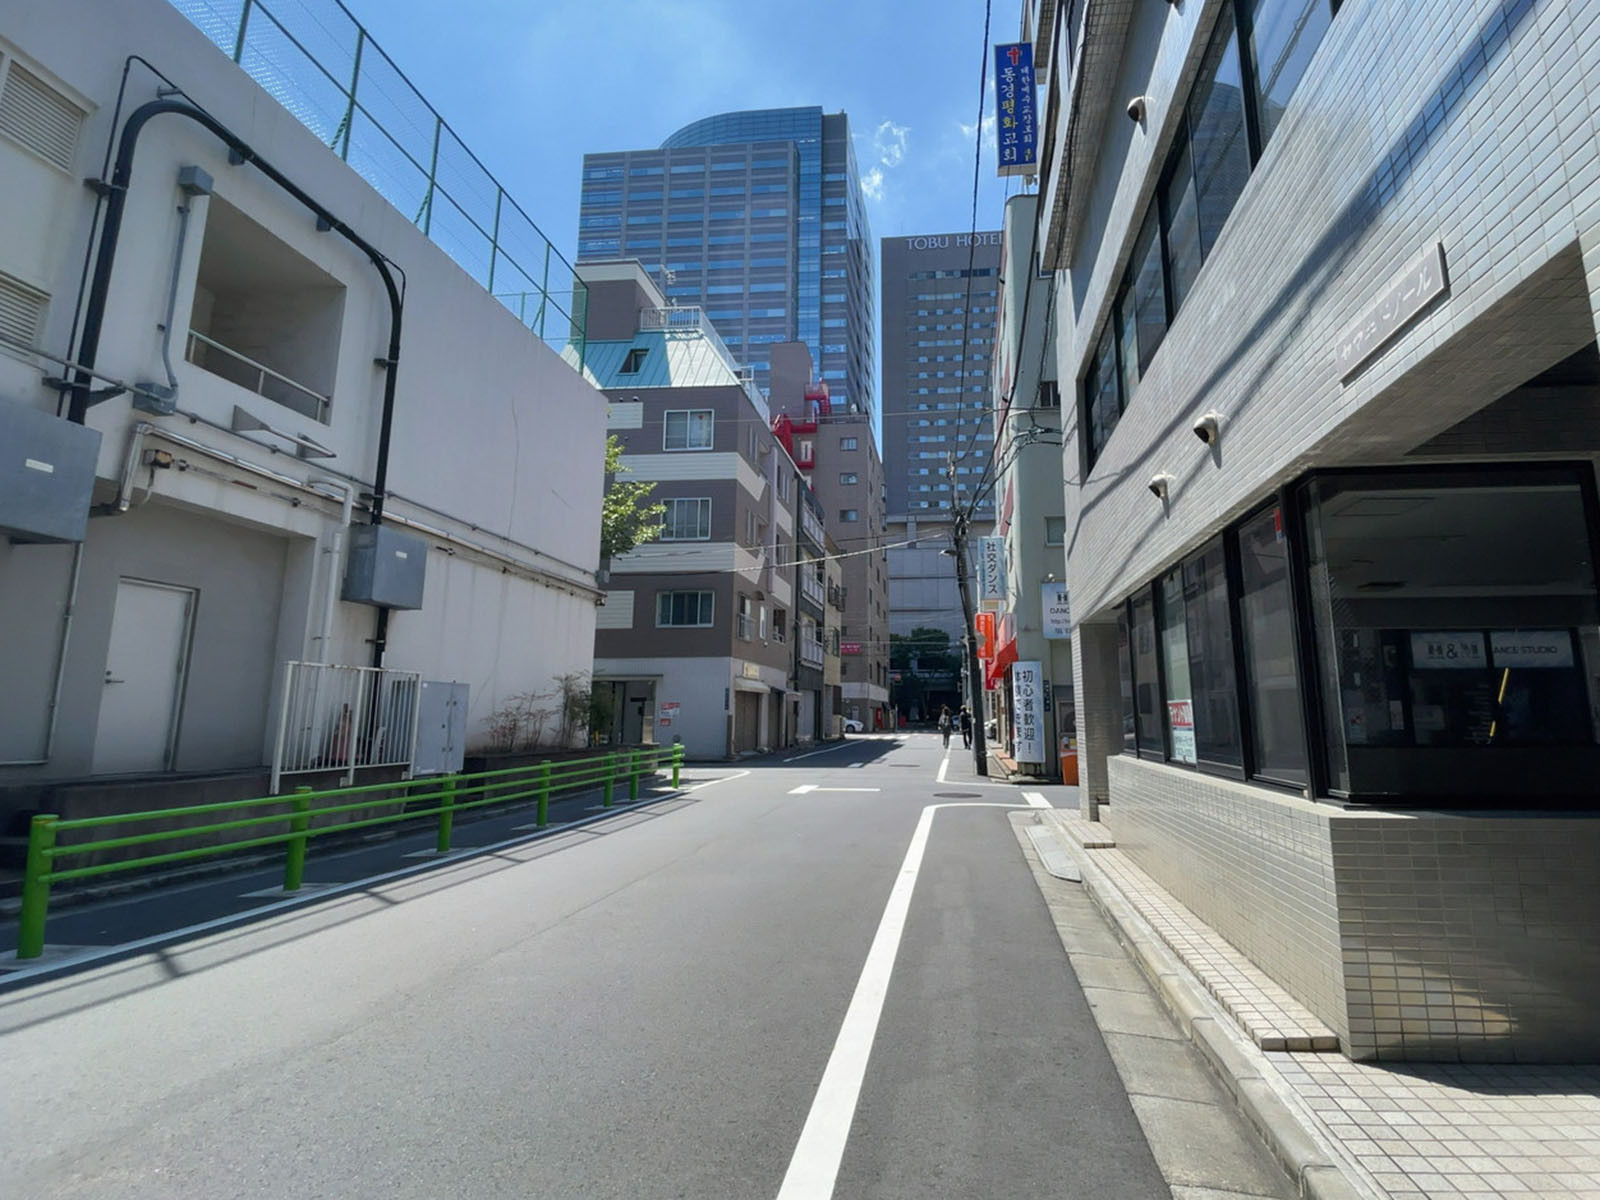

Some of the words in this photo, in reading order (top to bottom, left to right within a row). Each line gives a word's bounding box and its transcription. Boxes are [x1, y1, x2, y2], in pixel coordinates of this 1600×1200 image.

[1000, 66, 1019, 161] 동경평화교회
[905, 236, 949, 250] TOBU
[986, 541, 998, 594] 社交ダンス
[1494, 645, 1518, 655] ANCE
[1521, 645, 1558, 655] STUDIO
